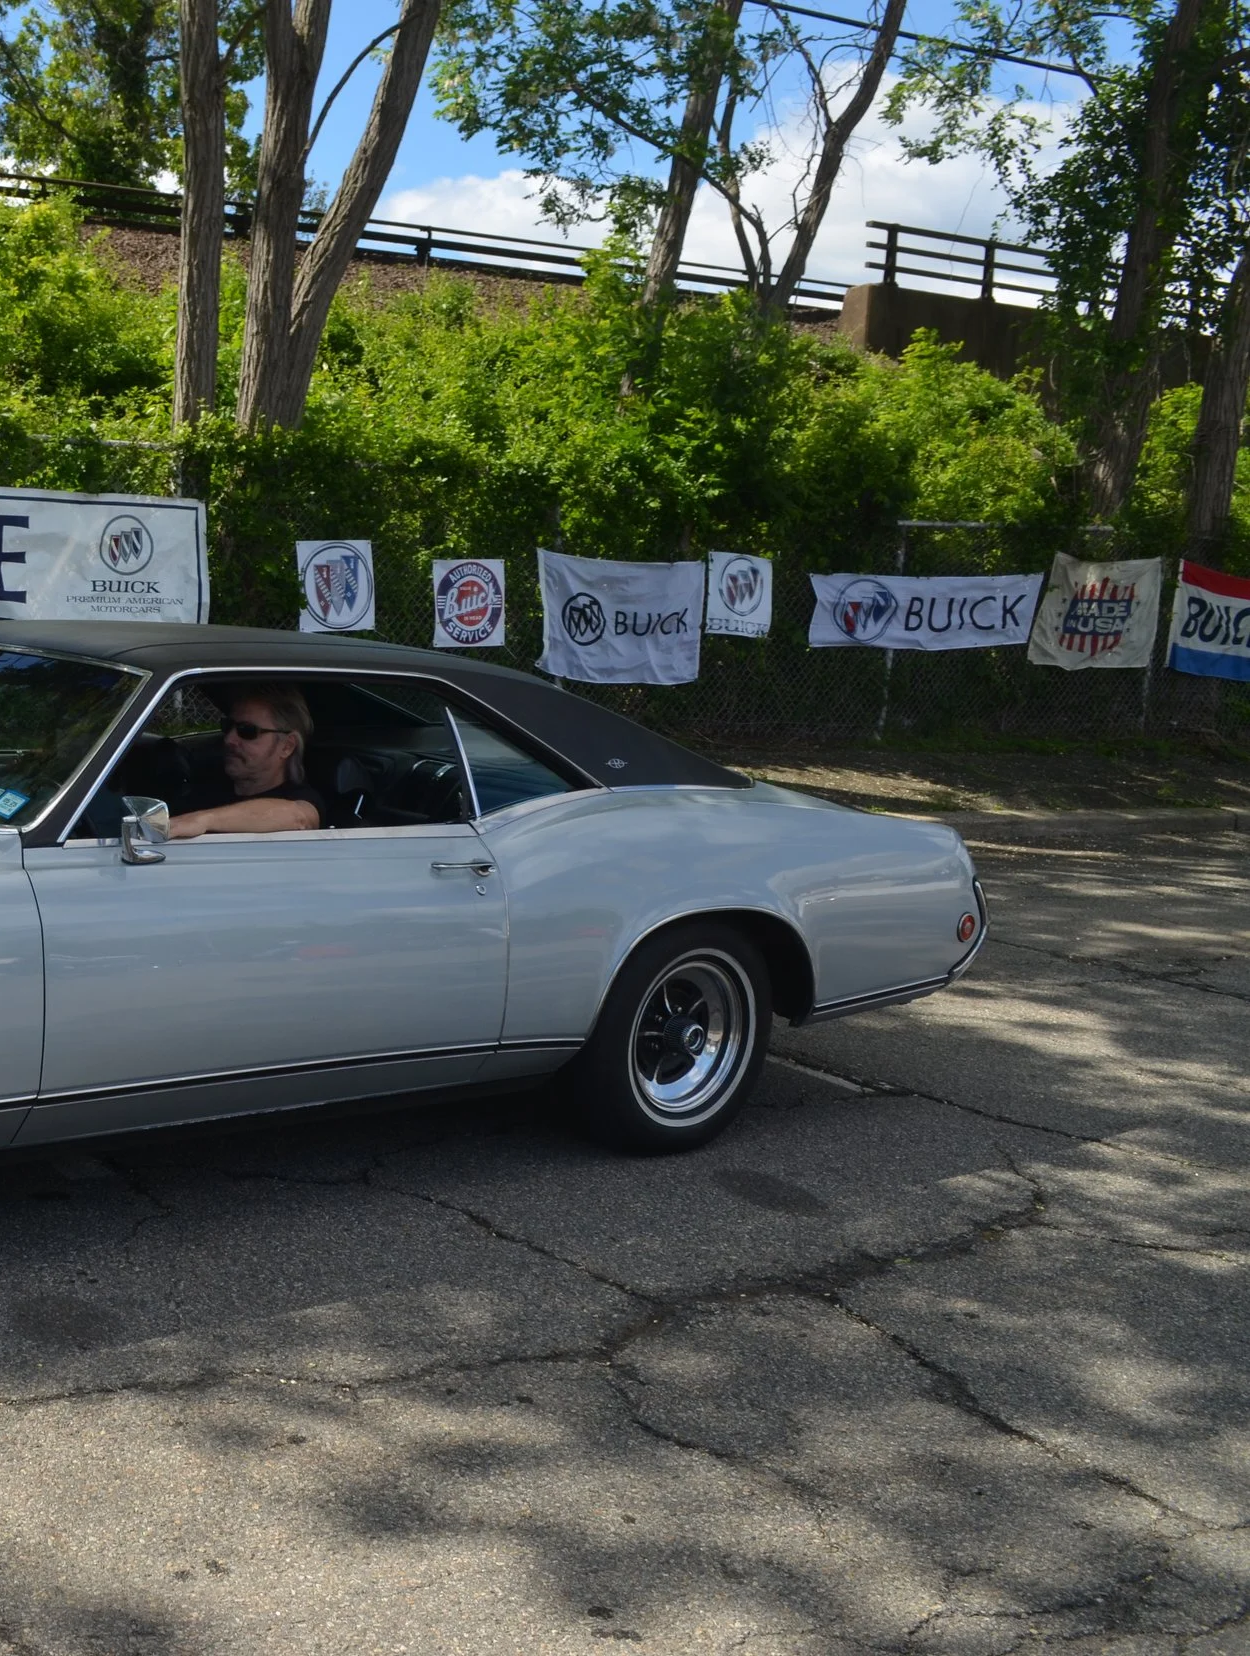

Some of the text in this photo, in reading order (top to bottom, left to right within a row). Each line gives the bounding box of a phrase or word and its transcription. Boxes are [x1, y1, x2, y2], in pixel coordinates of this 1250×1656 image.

[448, 564, 492, 583] AUTHORIZED
[91, 579, 161, 594] BUICK
[66, 595, 185, 606] PREMIUM AMERICAN
[90, 605, 161, 614] MOTORCARS
[443, 583, 498, 620] Buick
[1071, 601, 1128, 617] MADE
[613, 607, 688, 637] BUICK
[903, 594, 1028, 633] BUICK
[1180, 596, 1250, 648] BUIC
[445, 620, 494, 642] SERVICE
[707, 617, 769, 636] BUICK
[1066, 617, 1125, 633] IN USA
